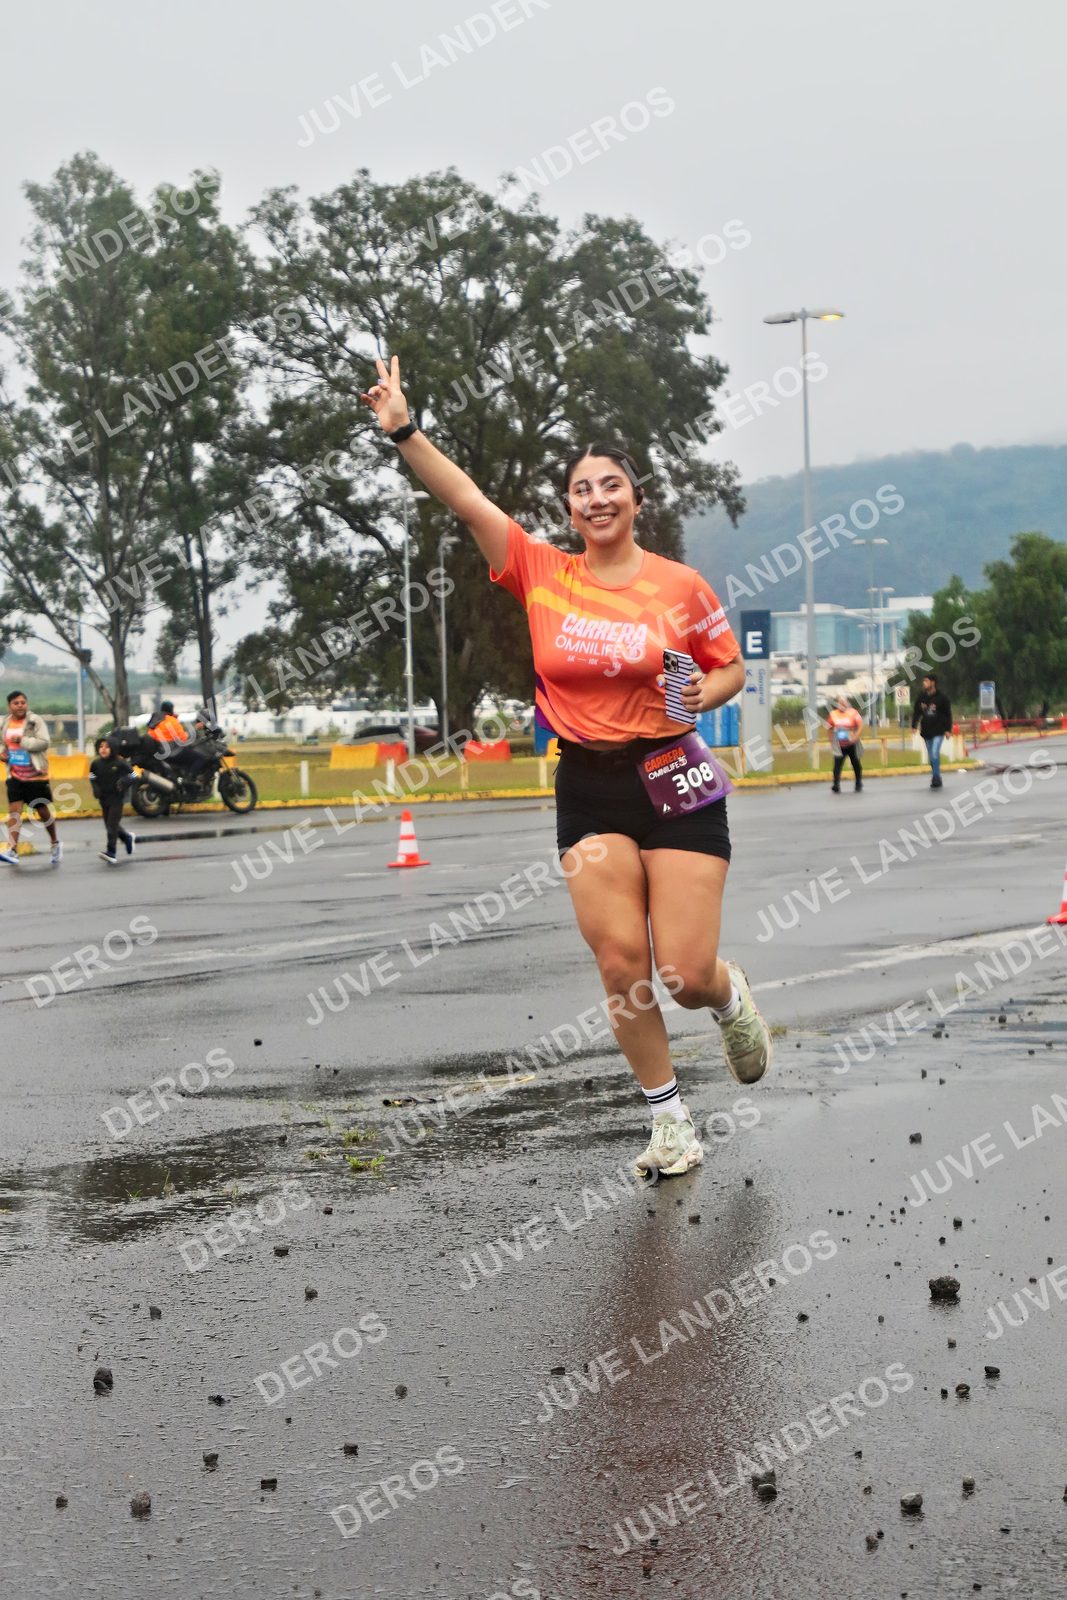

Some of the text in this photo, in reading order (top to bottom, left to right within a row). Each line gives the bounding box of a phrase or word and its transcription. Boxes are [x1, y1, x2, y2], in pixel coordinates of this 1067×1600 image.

[561, 612, 648, 643] CARRERA
[747, 631, 763, 653] E
[644, 746, 686, 774] CARRERA
[672, 762, 714, 795] 308
